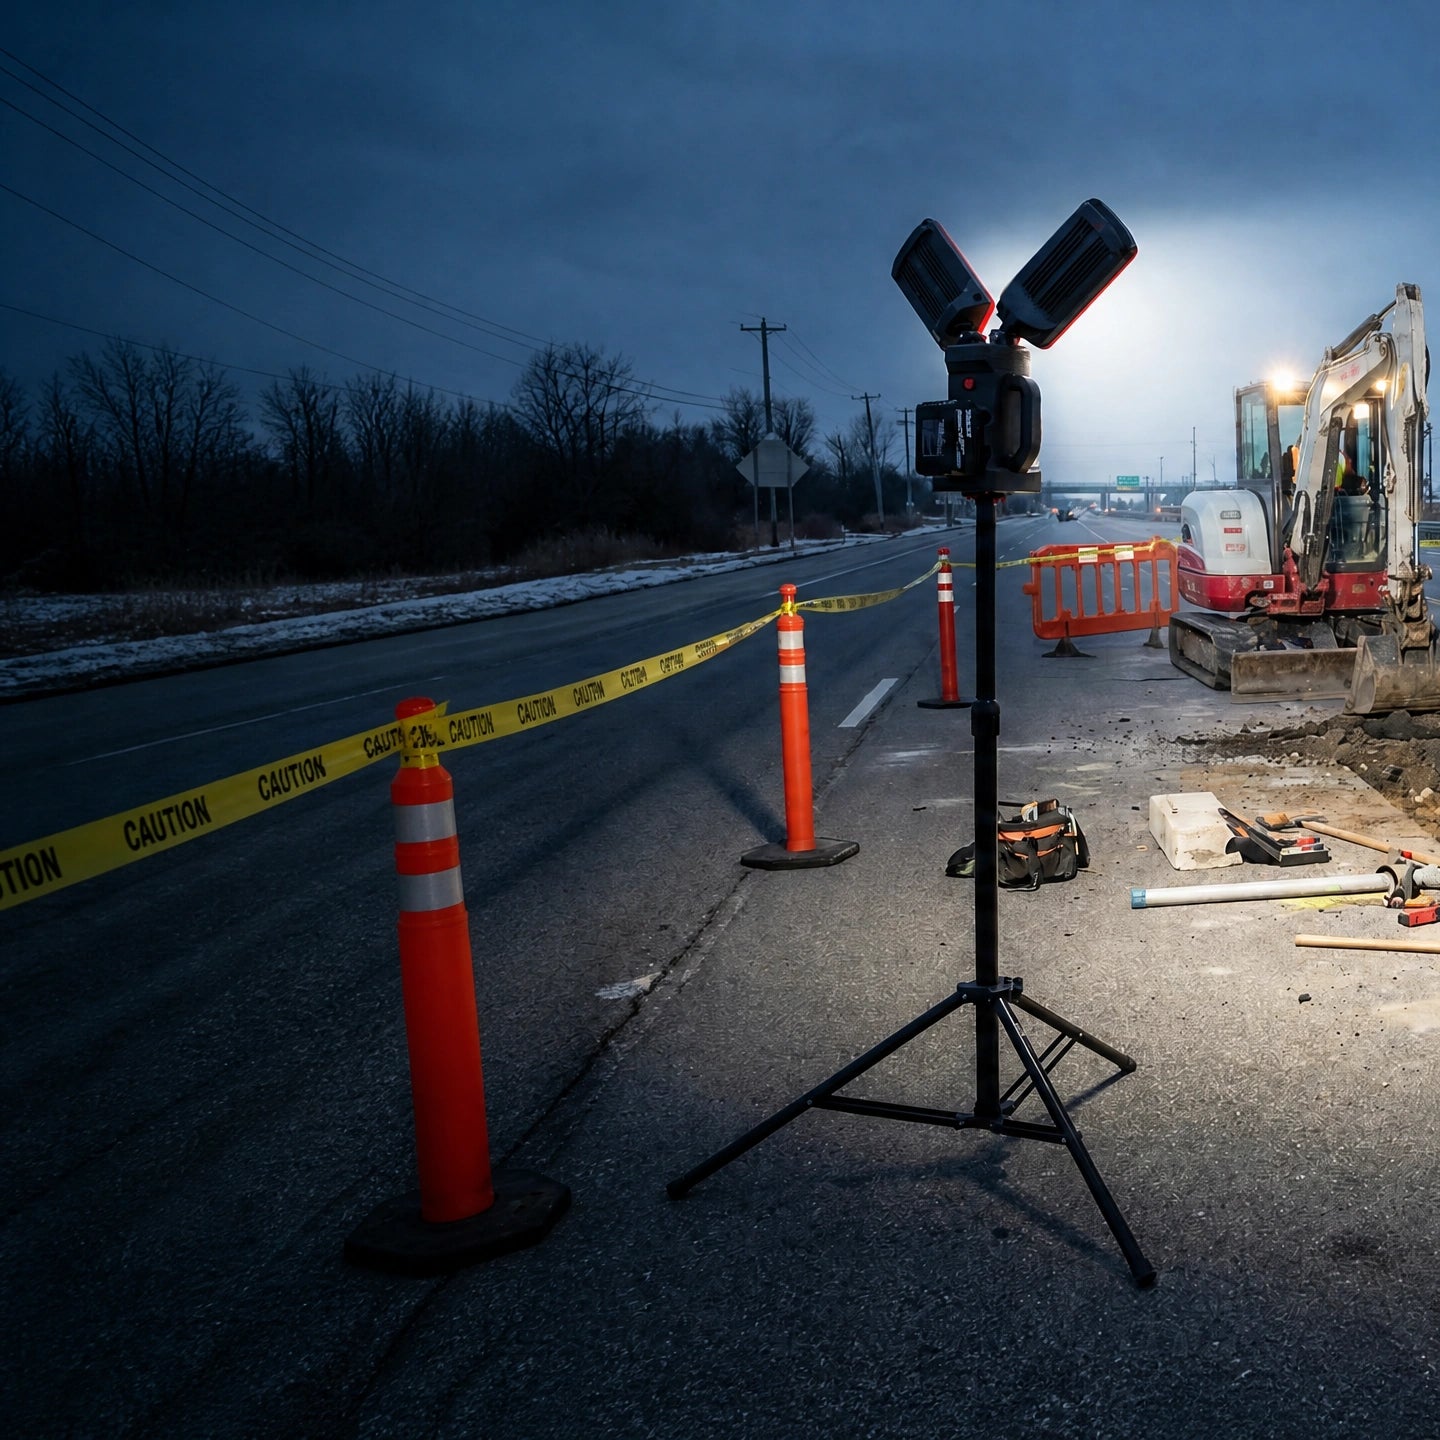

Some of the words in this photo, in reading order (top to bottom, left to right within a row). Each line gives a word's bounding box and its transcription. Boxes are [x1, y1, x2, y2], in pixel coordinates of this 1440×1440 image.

[449, 711, 495, 744] CAUTION
[517, 695, 557, 725] CAUTION
[0, 846, 63, 900] TION
[123, 795, 212, 851] CAUTION
[257, 754, 327, 801] CAUTION
